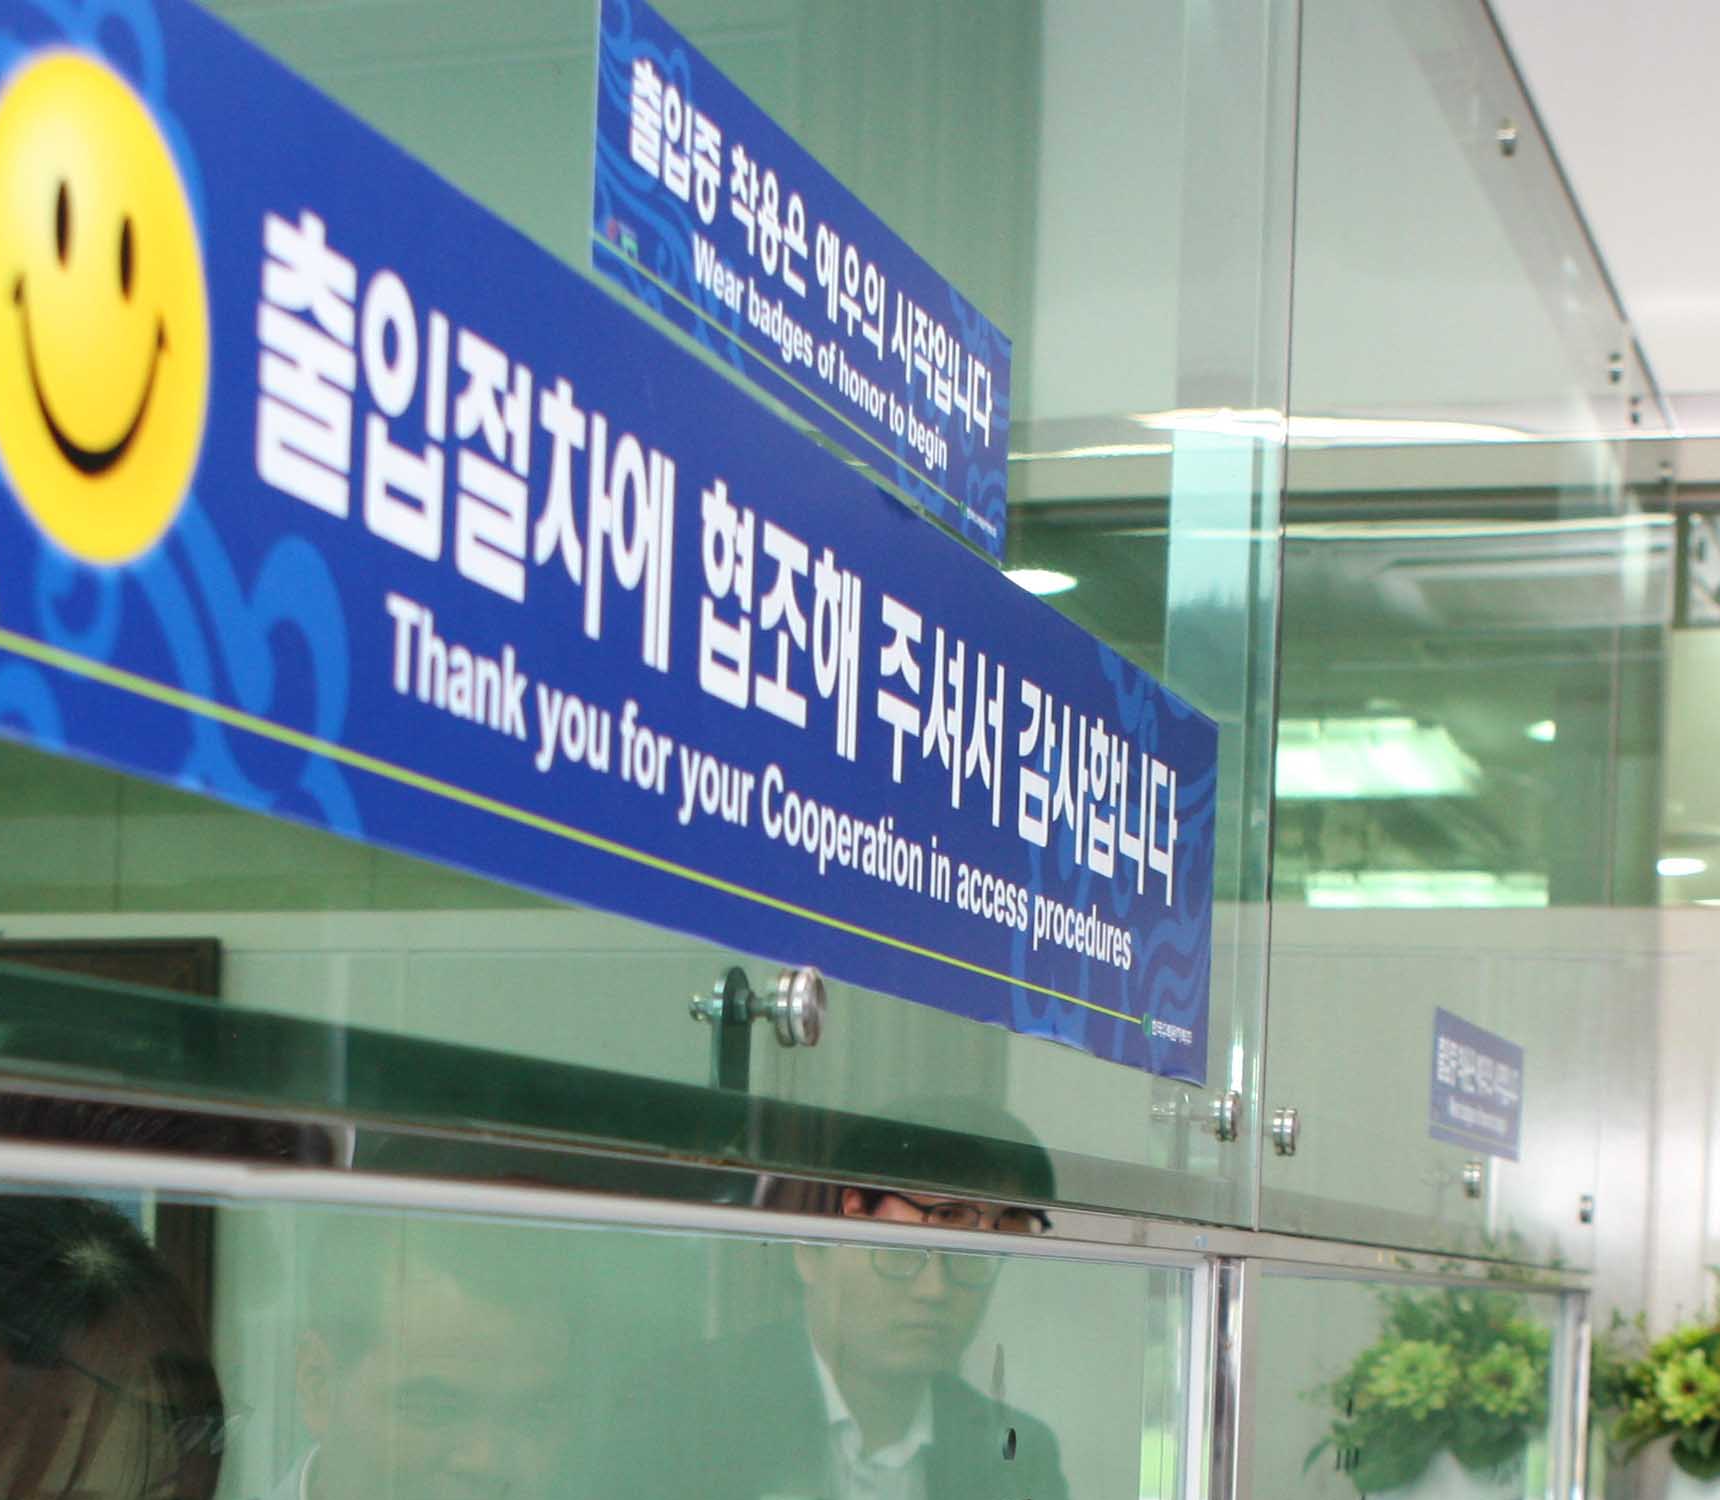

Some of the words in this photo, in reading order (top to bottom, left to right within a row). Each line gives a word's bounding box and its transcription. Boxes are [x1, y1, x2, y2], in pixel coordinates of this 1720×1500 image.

[630, 58, 722, 225] 출입증
[730, 143, 808, 298] 착용은
[815, 223, 886, 361] 예우의
[891, 290, 992, 448] 시작입니다
[693, 231, 744, 315] Wear
[748, 277, 813, 368] badges
[818, 342, 836, 385] of
[839, 350, 887, 422] honor
[889, 393, 904, 438] to
[908, 405, 949, 472] begin
[256, 209, 675, 673] 출입절차에
[699, 478, 862, 763] 협조해
[877, 594, 1005, 828] 주셔서
[1018, 679, 1178, 907] 감사합니다
[386, 592, 528, 741] Thank
[535, 682, 611, 773] you
[620, 699, 673, 795] for
[679, 744, 755, 827] your
[761, 763, 923, 893] Cooperation
[930, 836, 951, 903] in
[957, 863, 1028, 932] access
[1033, 895, 1132, 970] procedures
